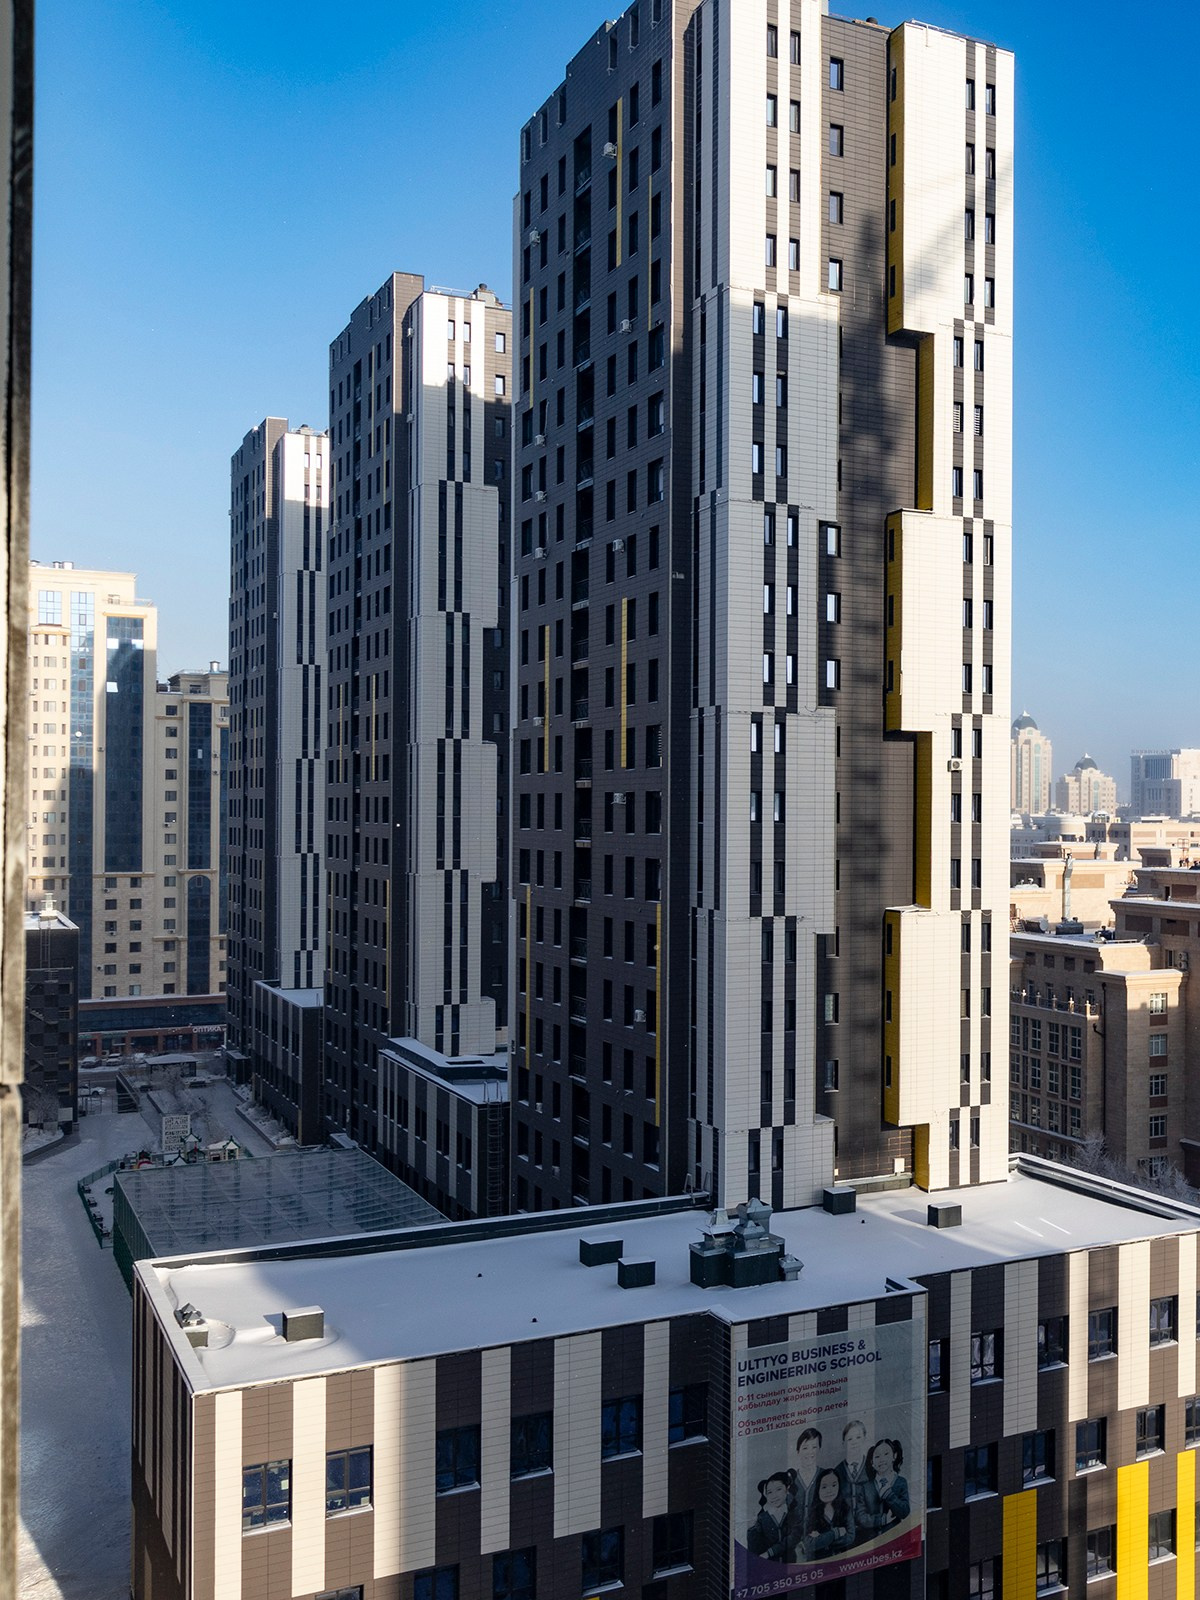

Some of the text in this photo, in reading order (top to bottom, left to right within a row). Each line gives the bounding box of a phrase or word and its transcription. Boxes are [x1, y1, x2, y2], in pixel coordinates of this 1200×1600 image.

[738, 1340, 866, 1372] ULTTYQ BUSINESS &
[738, 1351, 882, 1387] ENGINEERING SCHOOL
[738, 1376, 848, 1403] 0-11 сынып оқушыларына
[738, 1385, 842, 1412] қабылдау жарияланады
[738, 1400, 849, 1429] Объявляется набор детей
[745, 1427, 751, 1435] 0
[753, 1425, 764, 1434] по
[766, 1423, 774, 1431] 11
[775, 1418, 807, 1430] классы
[839, 1549, 903, 1573] www.ubes.kz
[736, 1568, 824, 1599] +7 705 350 55 05
